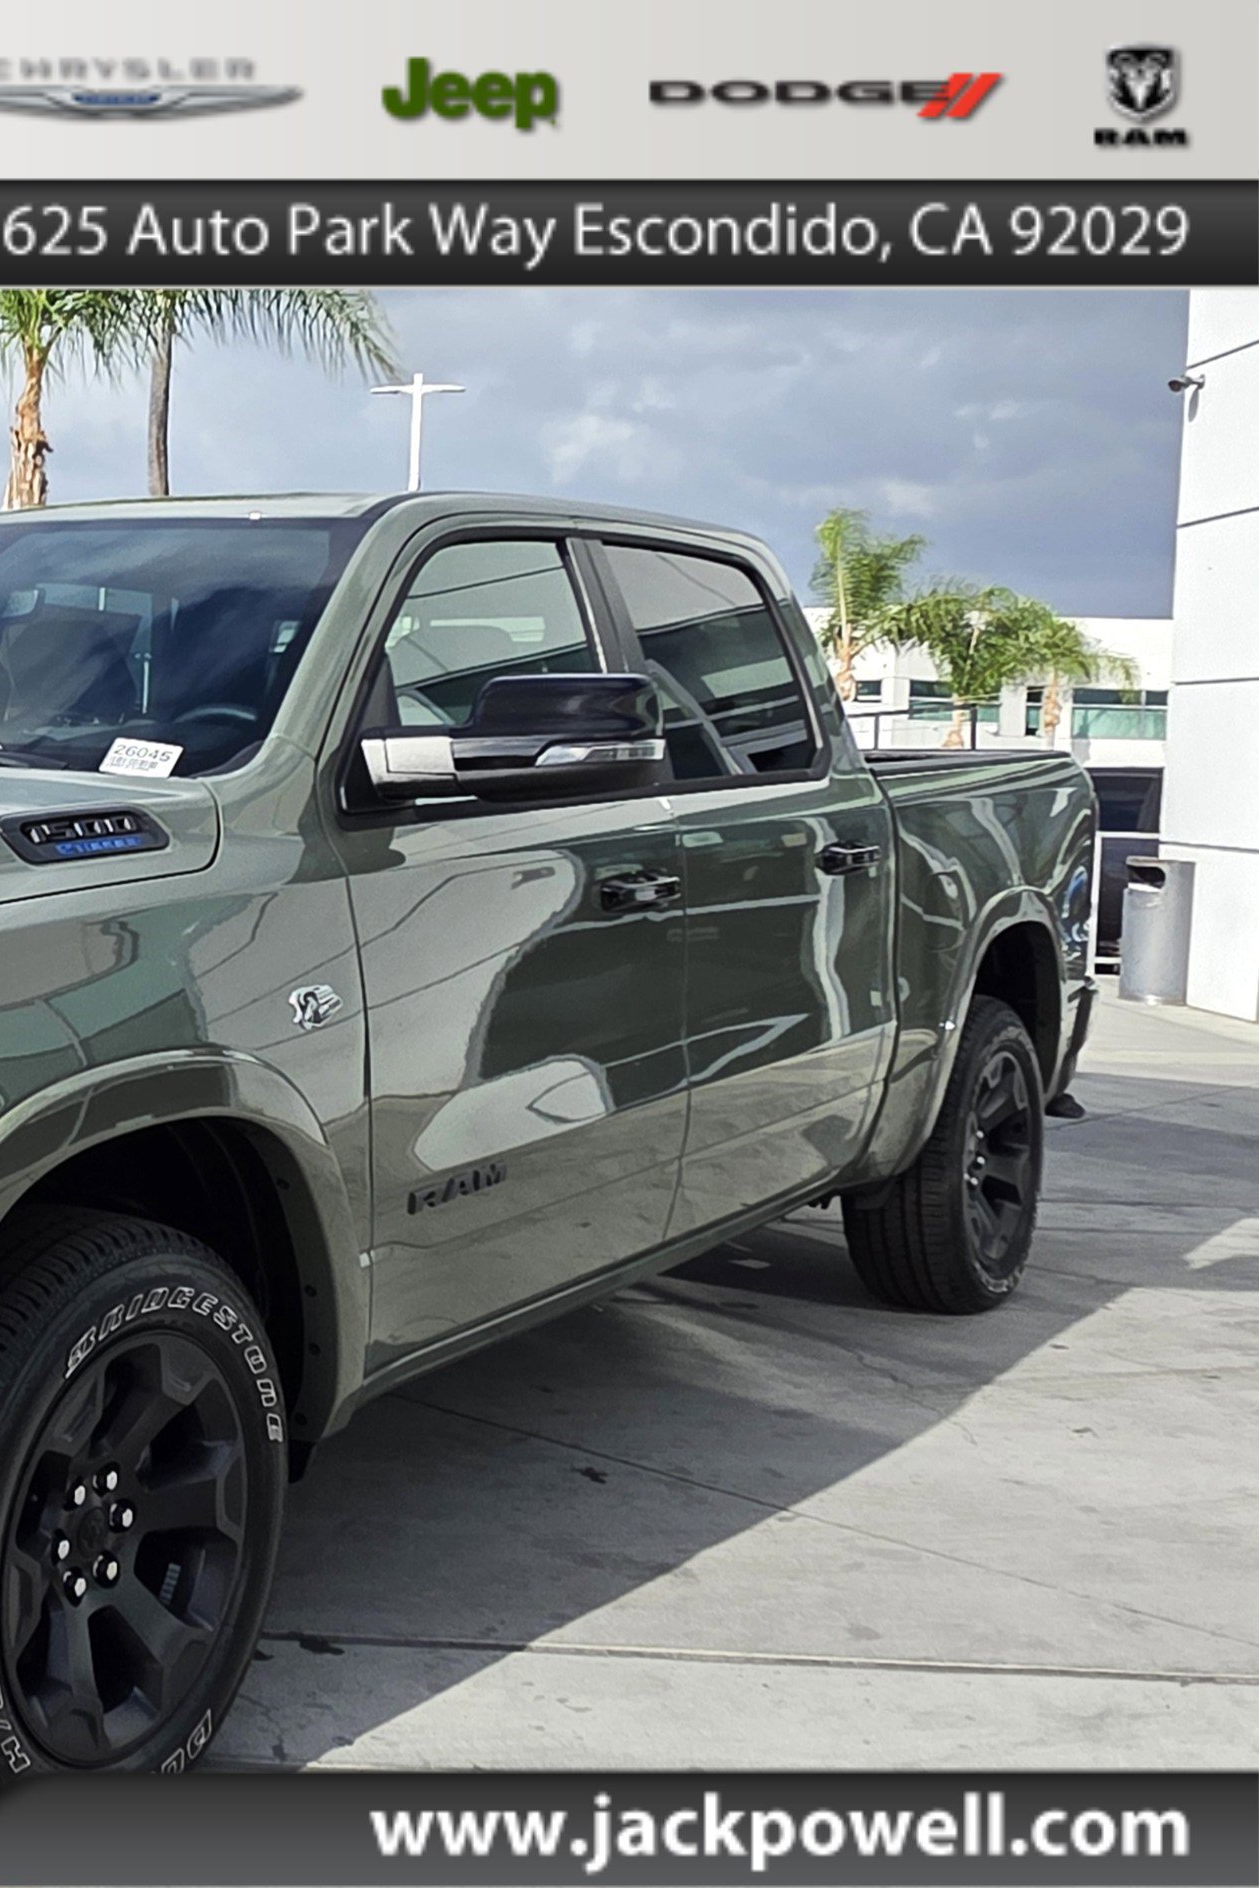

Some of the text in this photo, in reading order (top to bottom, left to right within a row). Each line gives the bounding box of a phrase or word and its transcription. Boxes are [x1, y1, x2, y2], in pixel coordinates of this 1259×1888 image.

[113, 744, 173, 763] 26045
[28, 816, 138, 844] 1500
[407, 1163, 508, 1215] RAM
[64, 1286, 284, 1442] BRIDGESTONE
